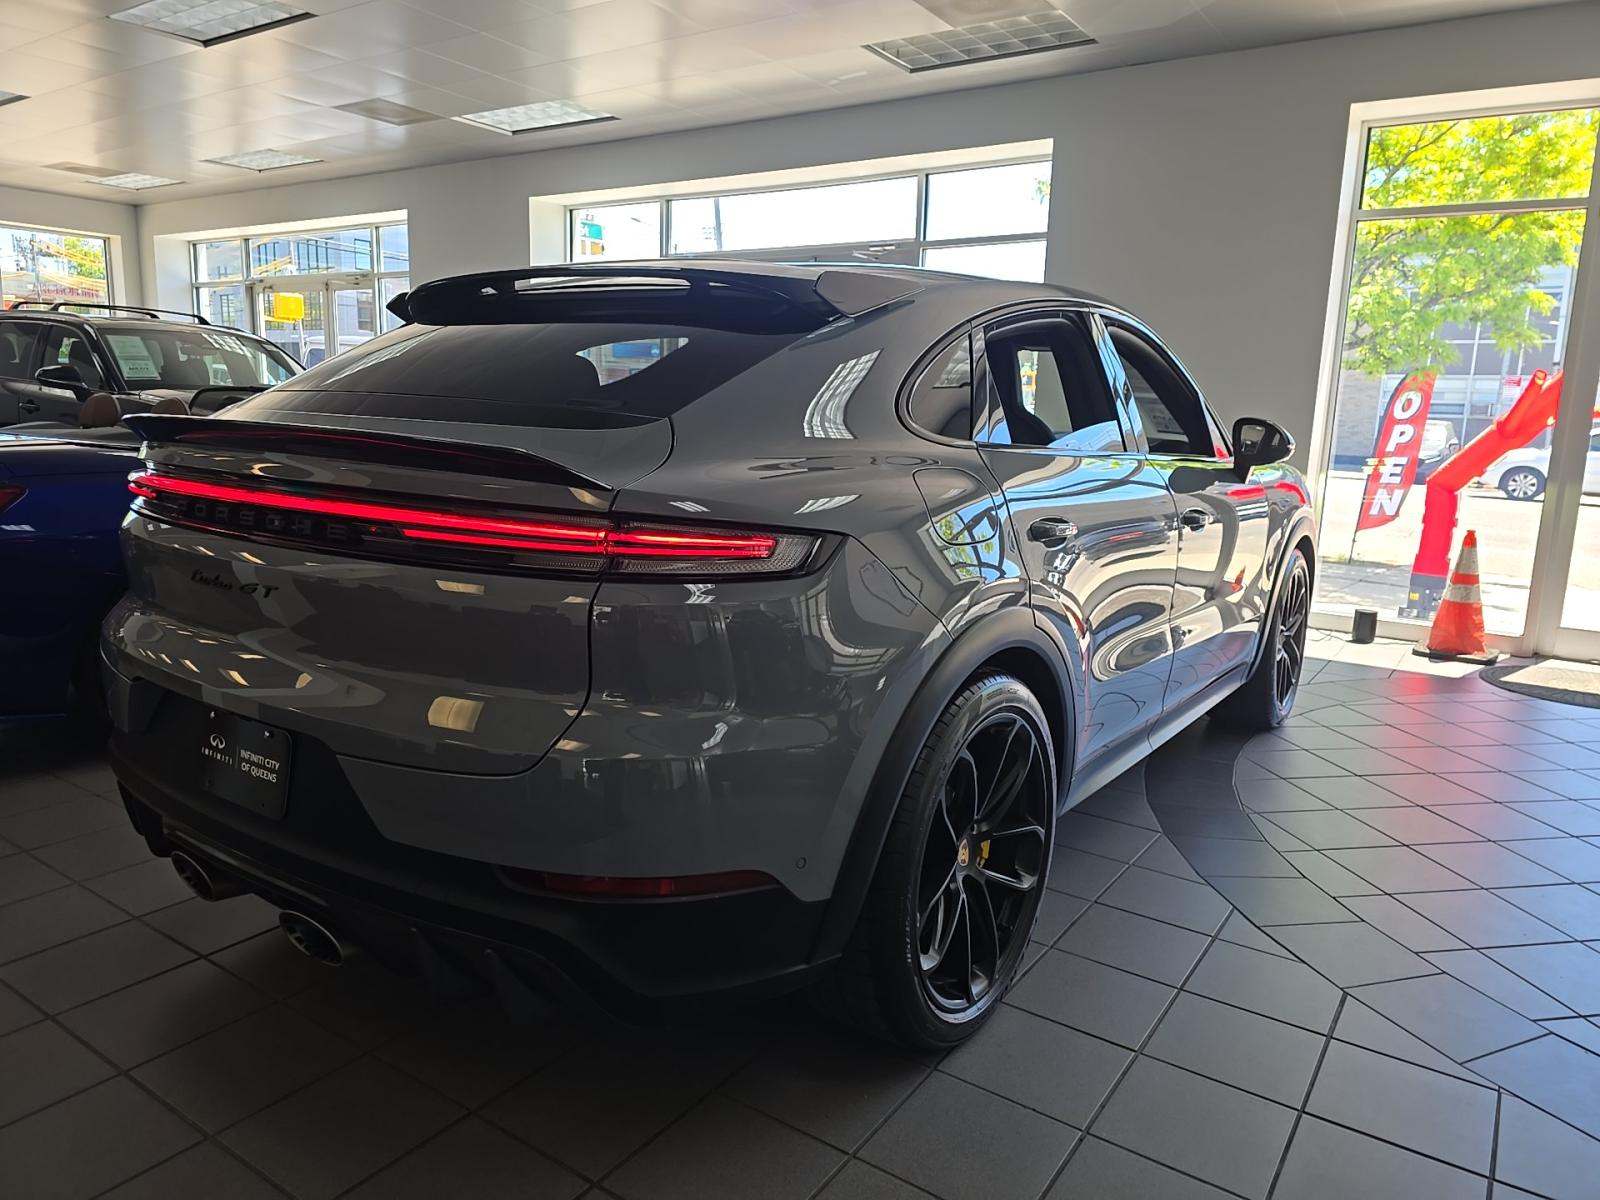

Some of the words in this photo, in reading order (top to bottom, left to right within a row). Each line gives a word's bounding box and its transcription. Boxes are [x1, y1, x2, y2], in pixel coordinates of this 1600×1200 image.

[1368, 389, 1424, 517] OPEN
[239, 582, 279, 598] GT
[201, 746, 232, 764] INFINITI
[240, 749, 264, 765] INFINITI
[264, 758, 279, 770] CITY
[241, 762, 250, 772] OF
[251, 767, 276, 782] QUEENS
